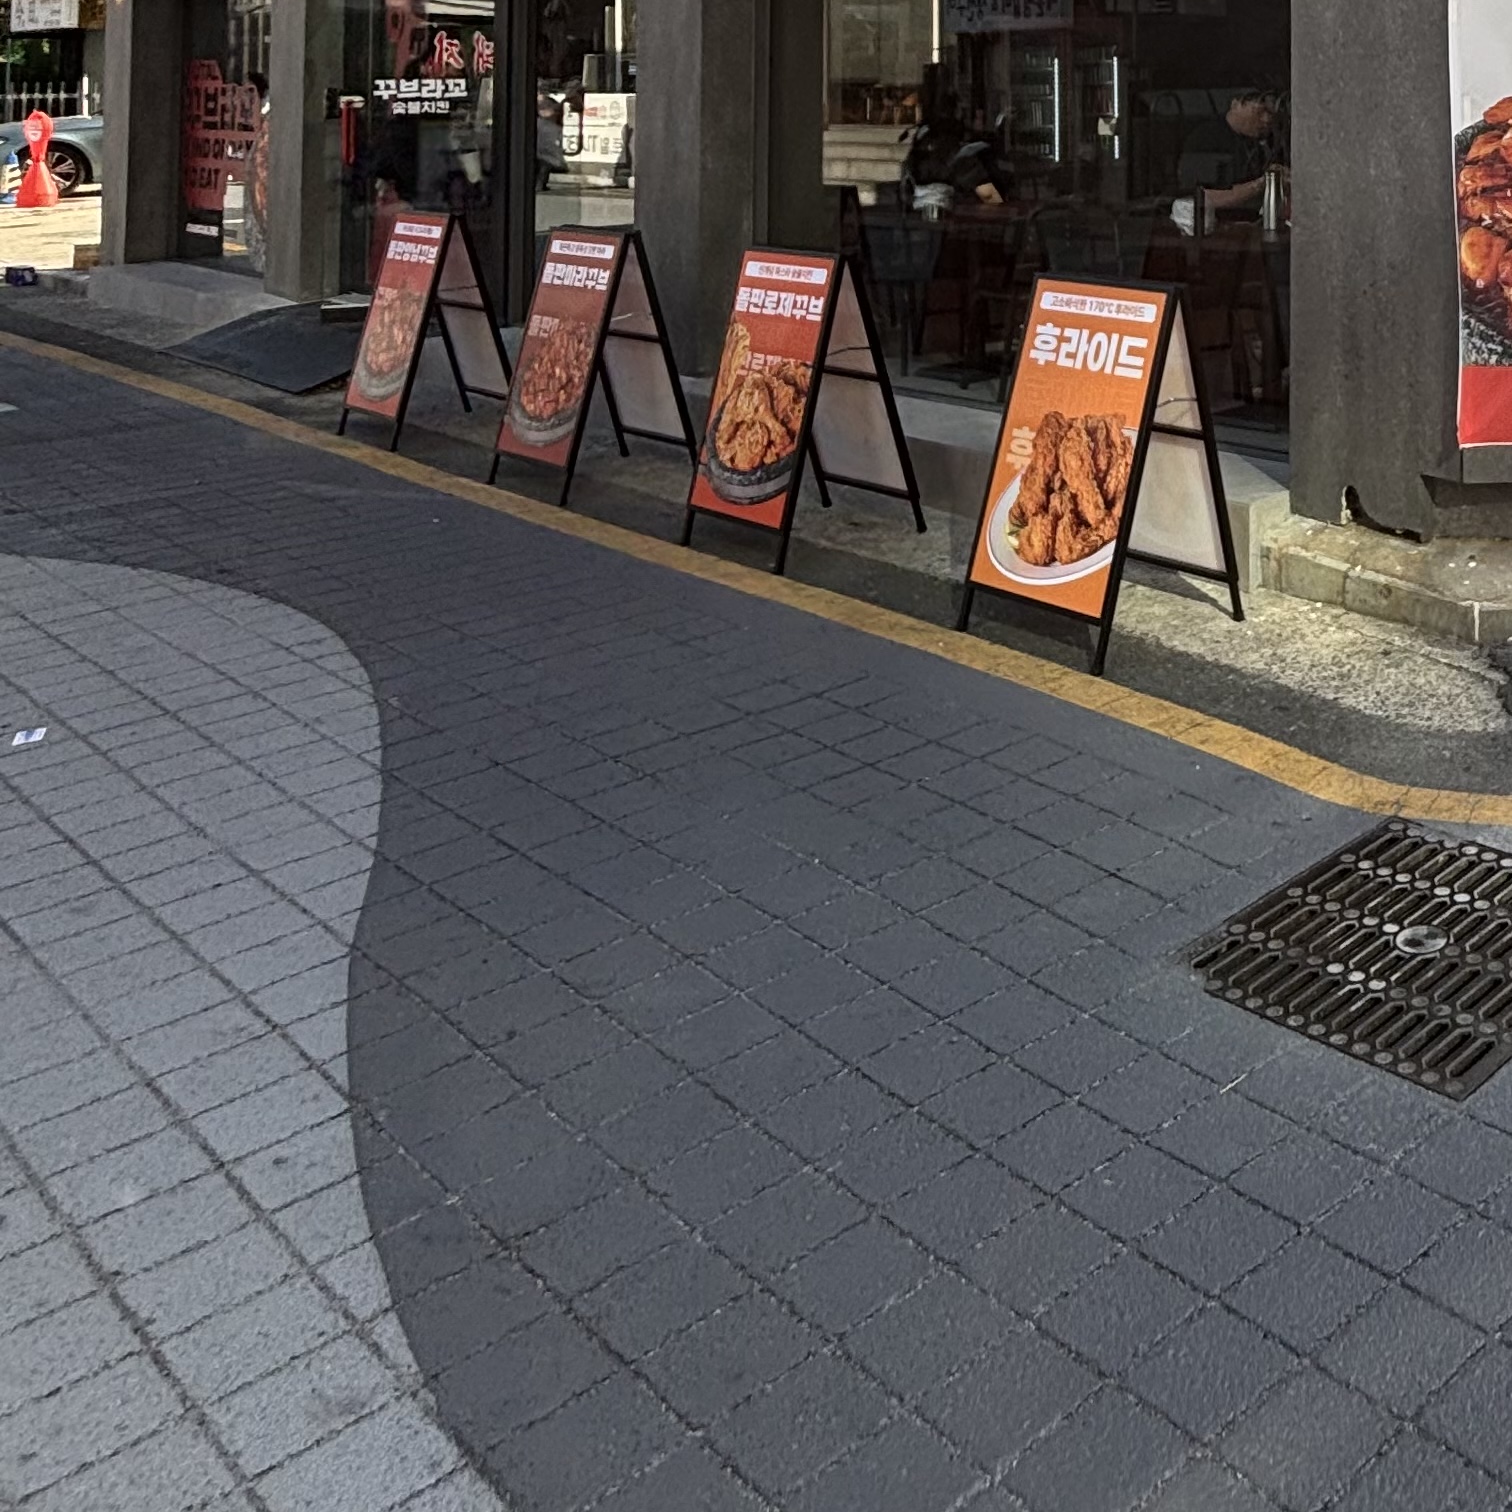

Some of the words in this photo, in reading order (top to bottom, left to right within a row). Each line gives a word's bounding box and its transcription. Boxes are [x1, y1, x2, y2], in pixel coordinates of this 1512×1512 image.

[373, 78, 469, 100] 꾸브라꼬
[735, 287, 824, 321] 돌판로제꾸브
[1029, 322, 1149, 380] 후라이드
